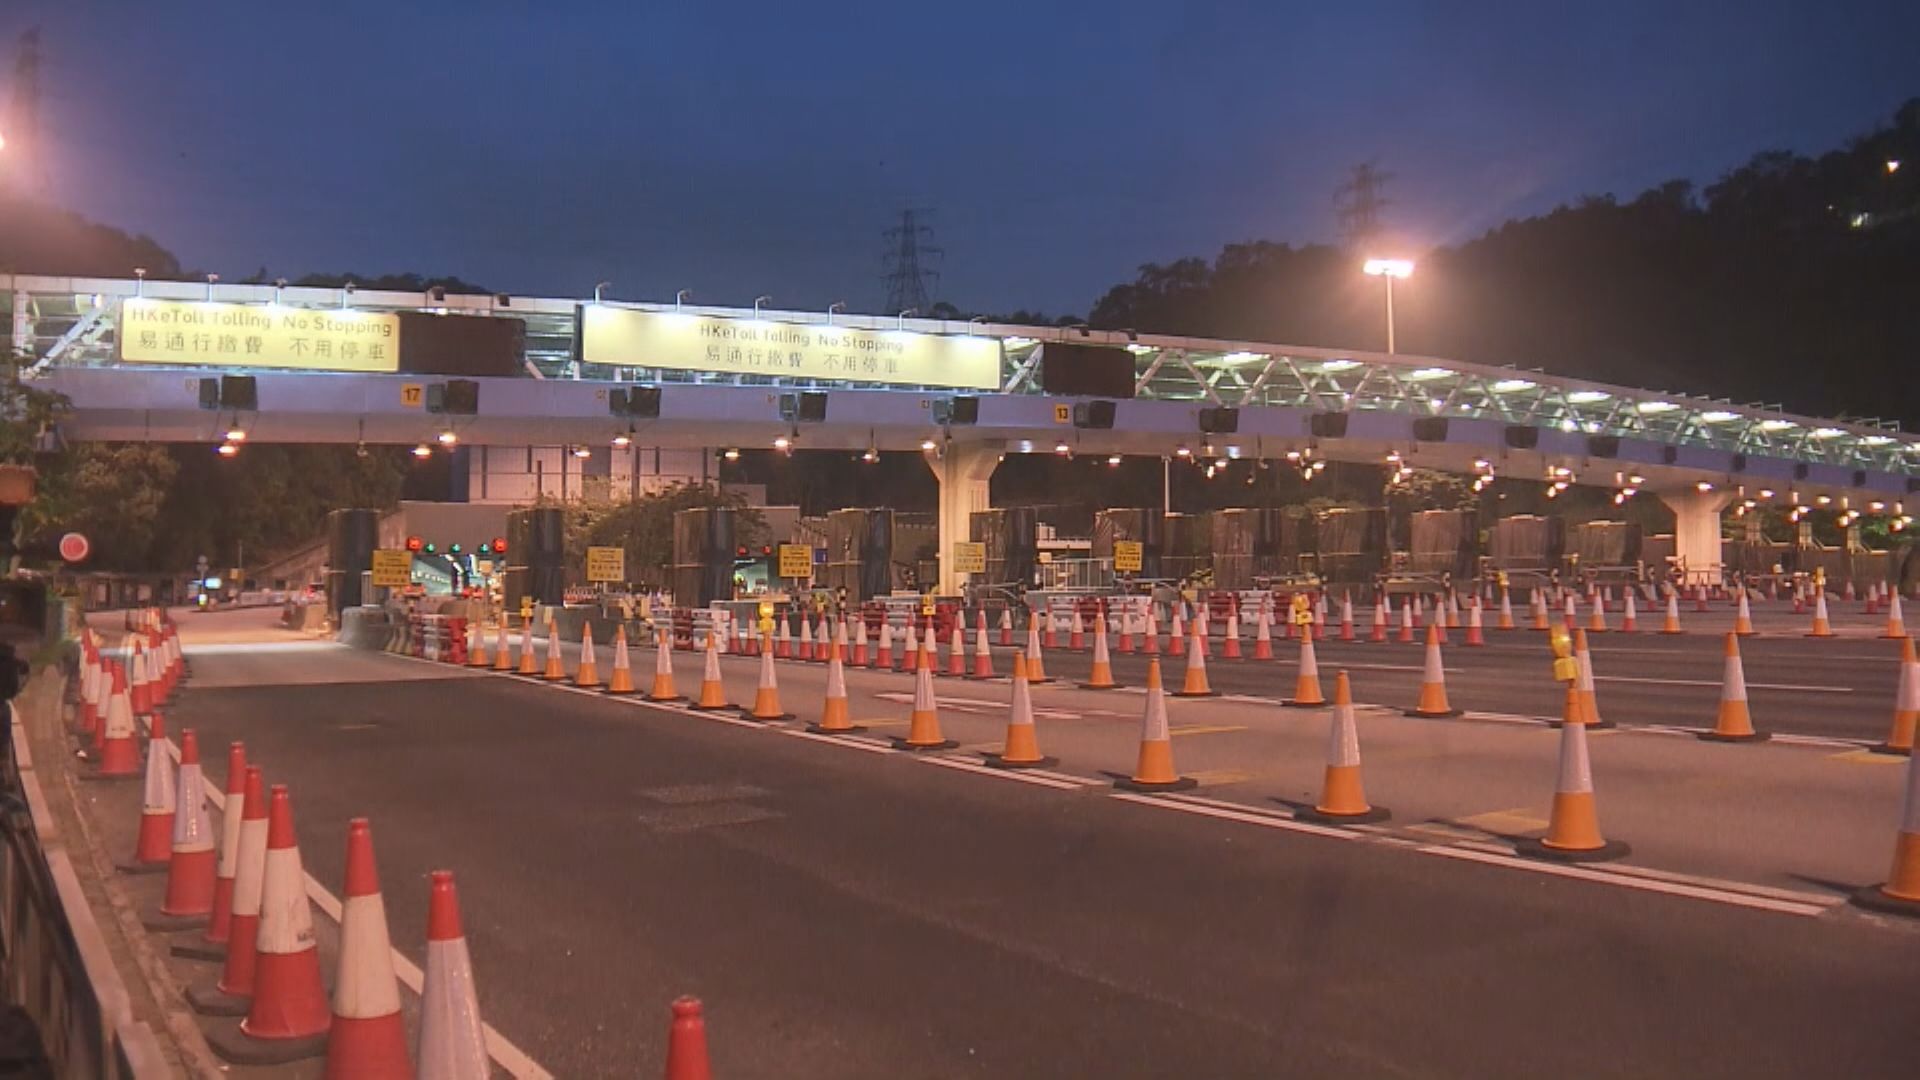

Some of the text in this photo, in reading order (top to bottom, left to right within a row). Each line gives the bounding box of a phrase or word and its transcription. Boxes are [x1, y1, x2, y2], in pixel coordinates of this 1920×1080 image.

[132, 308, 391, 337] HKeToll Tolling No Stopping
[289, 337, 385, 360] 不用停車
[700, 323, 904, 353] HKeToll Tolling No Stopping
[403, 387, 421, 401] 17
[1056, 407, 1068, 419] 13
